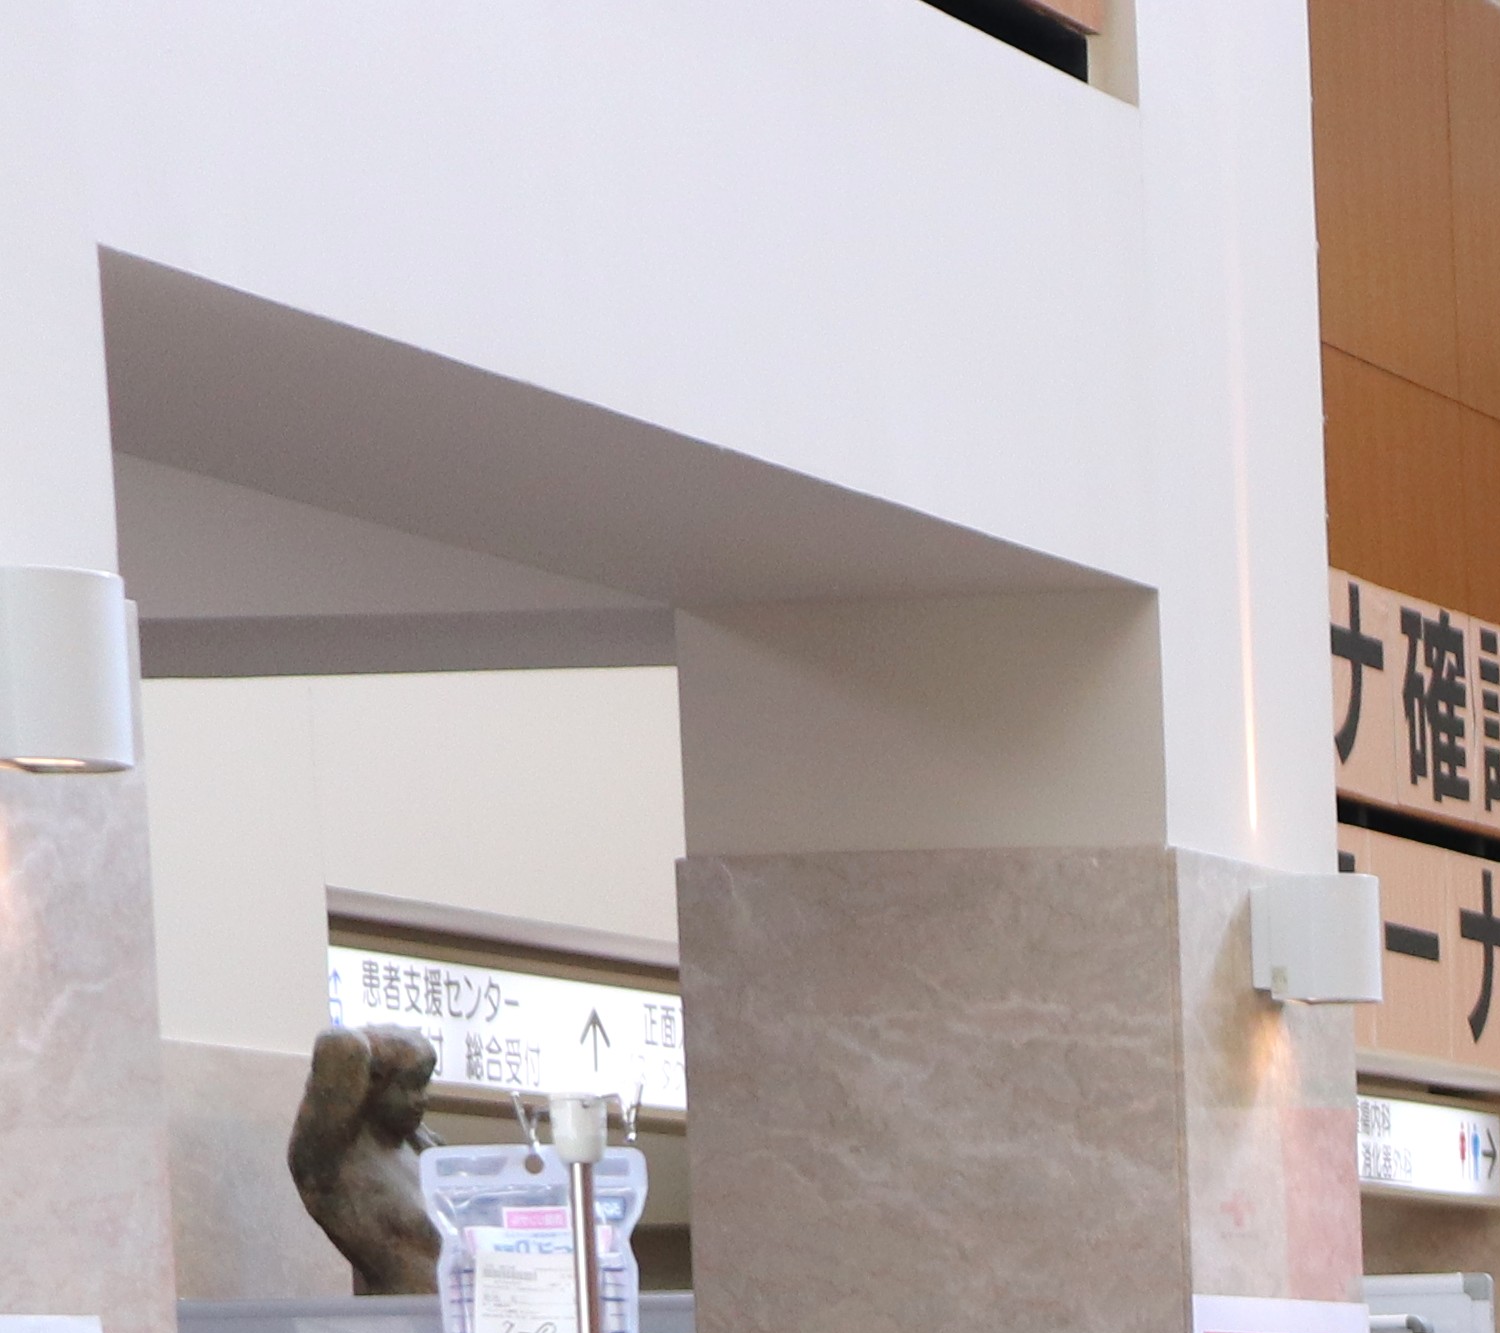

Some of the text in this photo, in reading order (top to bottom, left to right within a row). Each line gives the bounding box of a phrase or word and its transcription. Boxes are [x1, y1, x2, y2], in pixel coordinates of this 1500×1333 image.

[362, 959, 520, 1023] 患者支援センター
[644, 1003, 683, 1050] 正面
[466, 1031, 541, 1088] 総合受付
